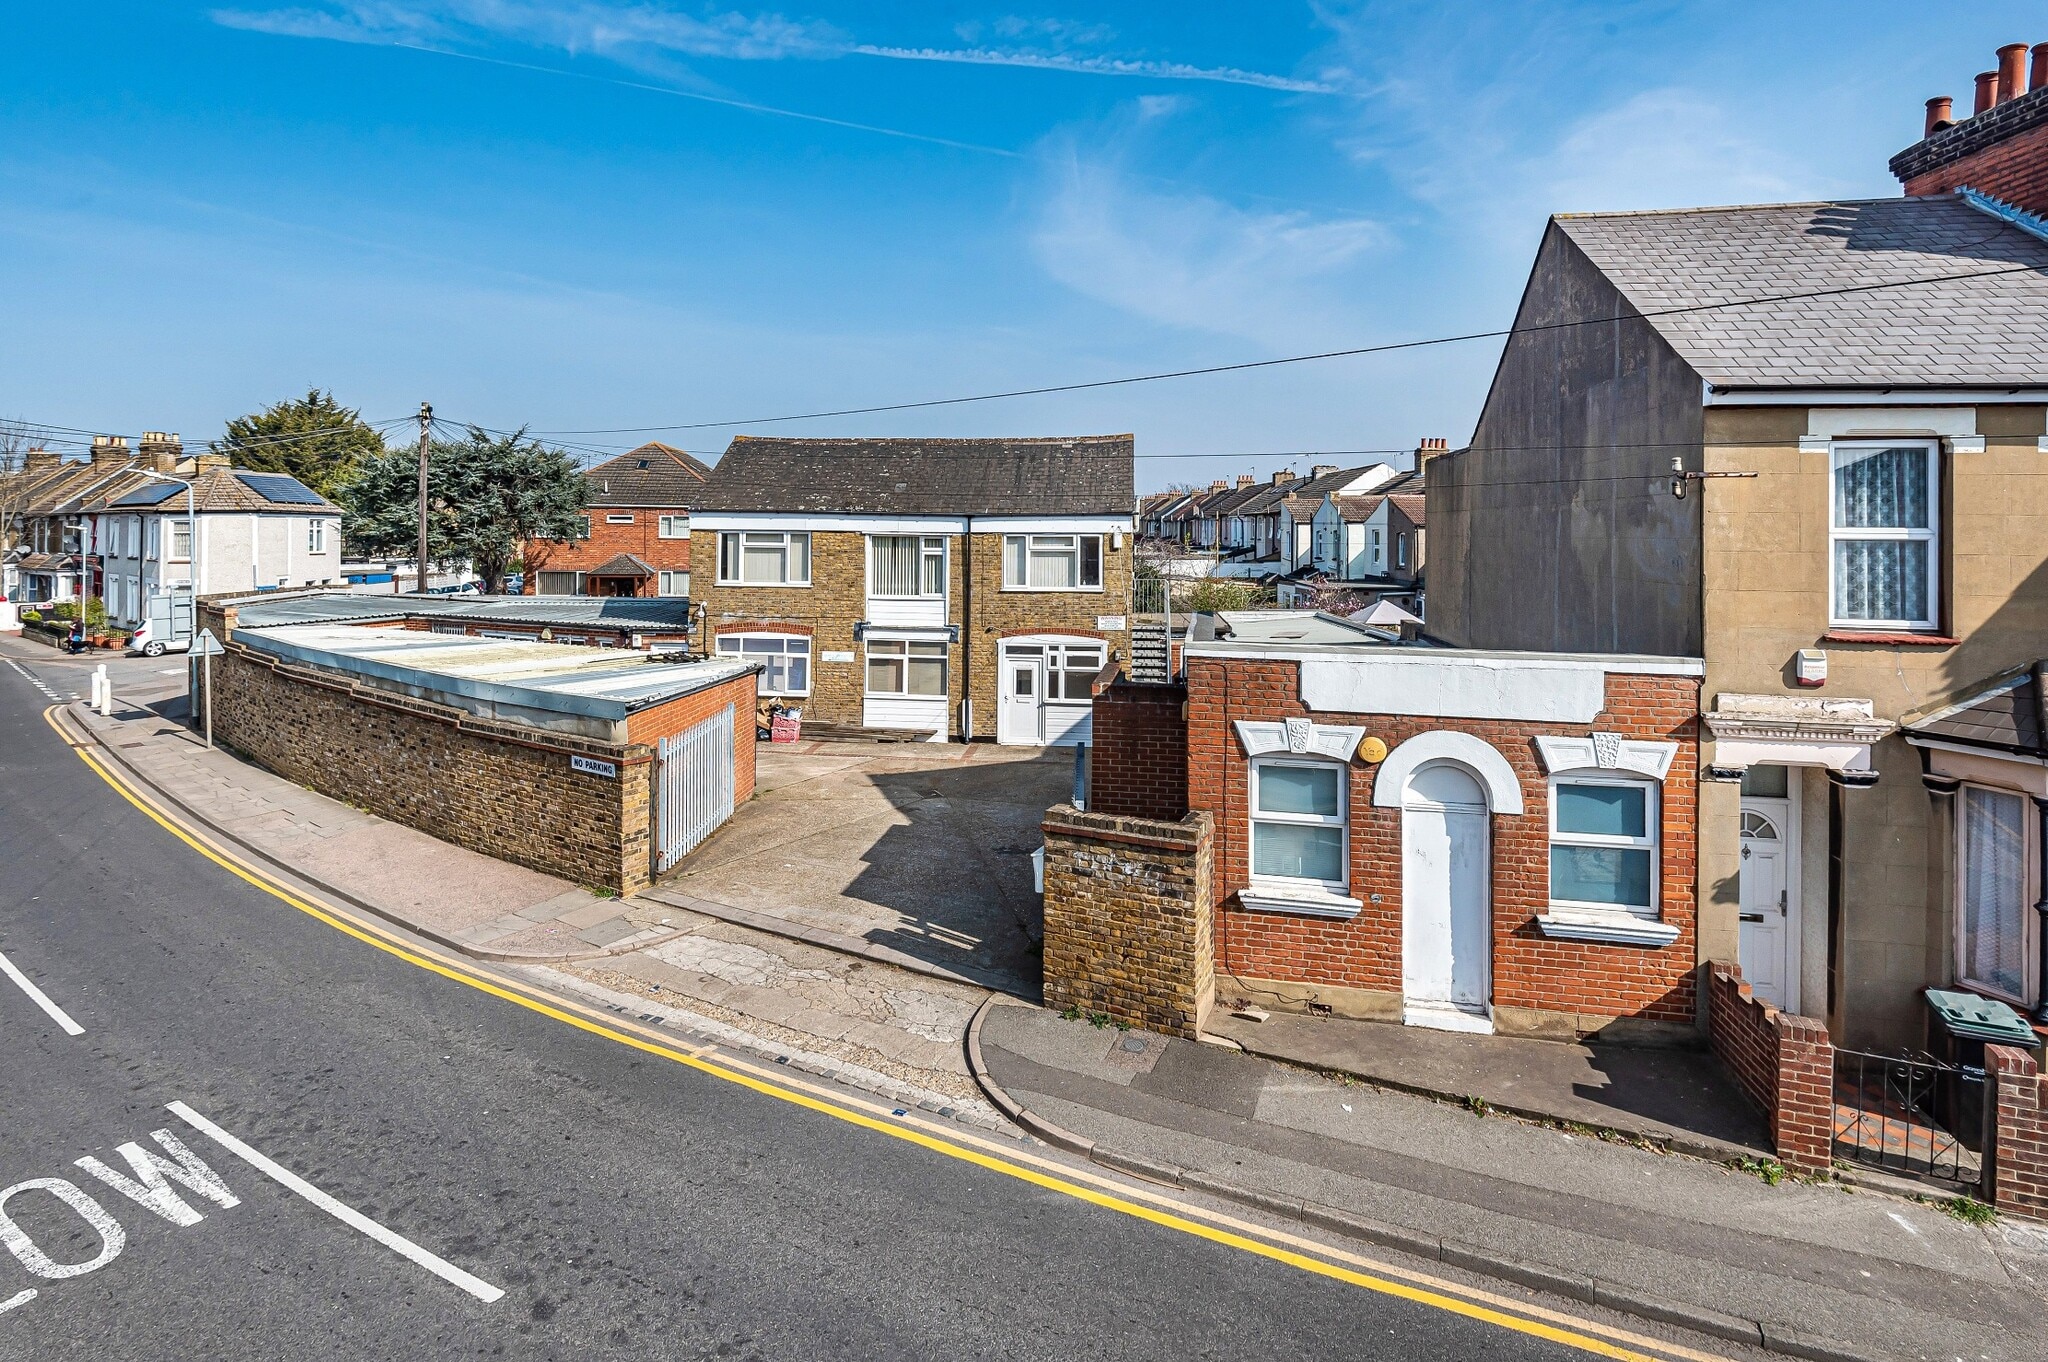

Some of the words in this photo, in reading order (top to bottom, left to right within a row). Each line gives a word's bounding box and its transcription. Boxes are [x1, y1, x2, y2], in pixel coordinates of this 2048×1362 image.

[574, 758, 583, 768] NO
[585, 760, 613, 774] PARKING
[0, 1128, 242, 1314] OW
